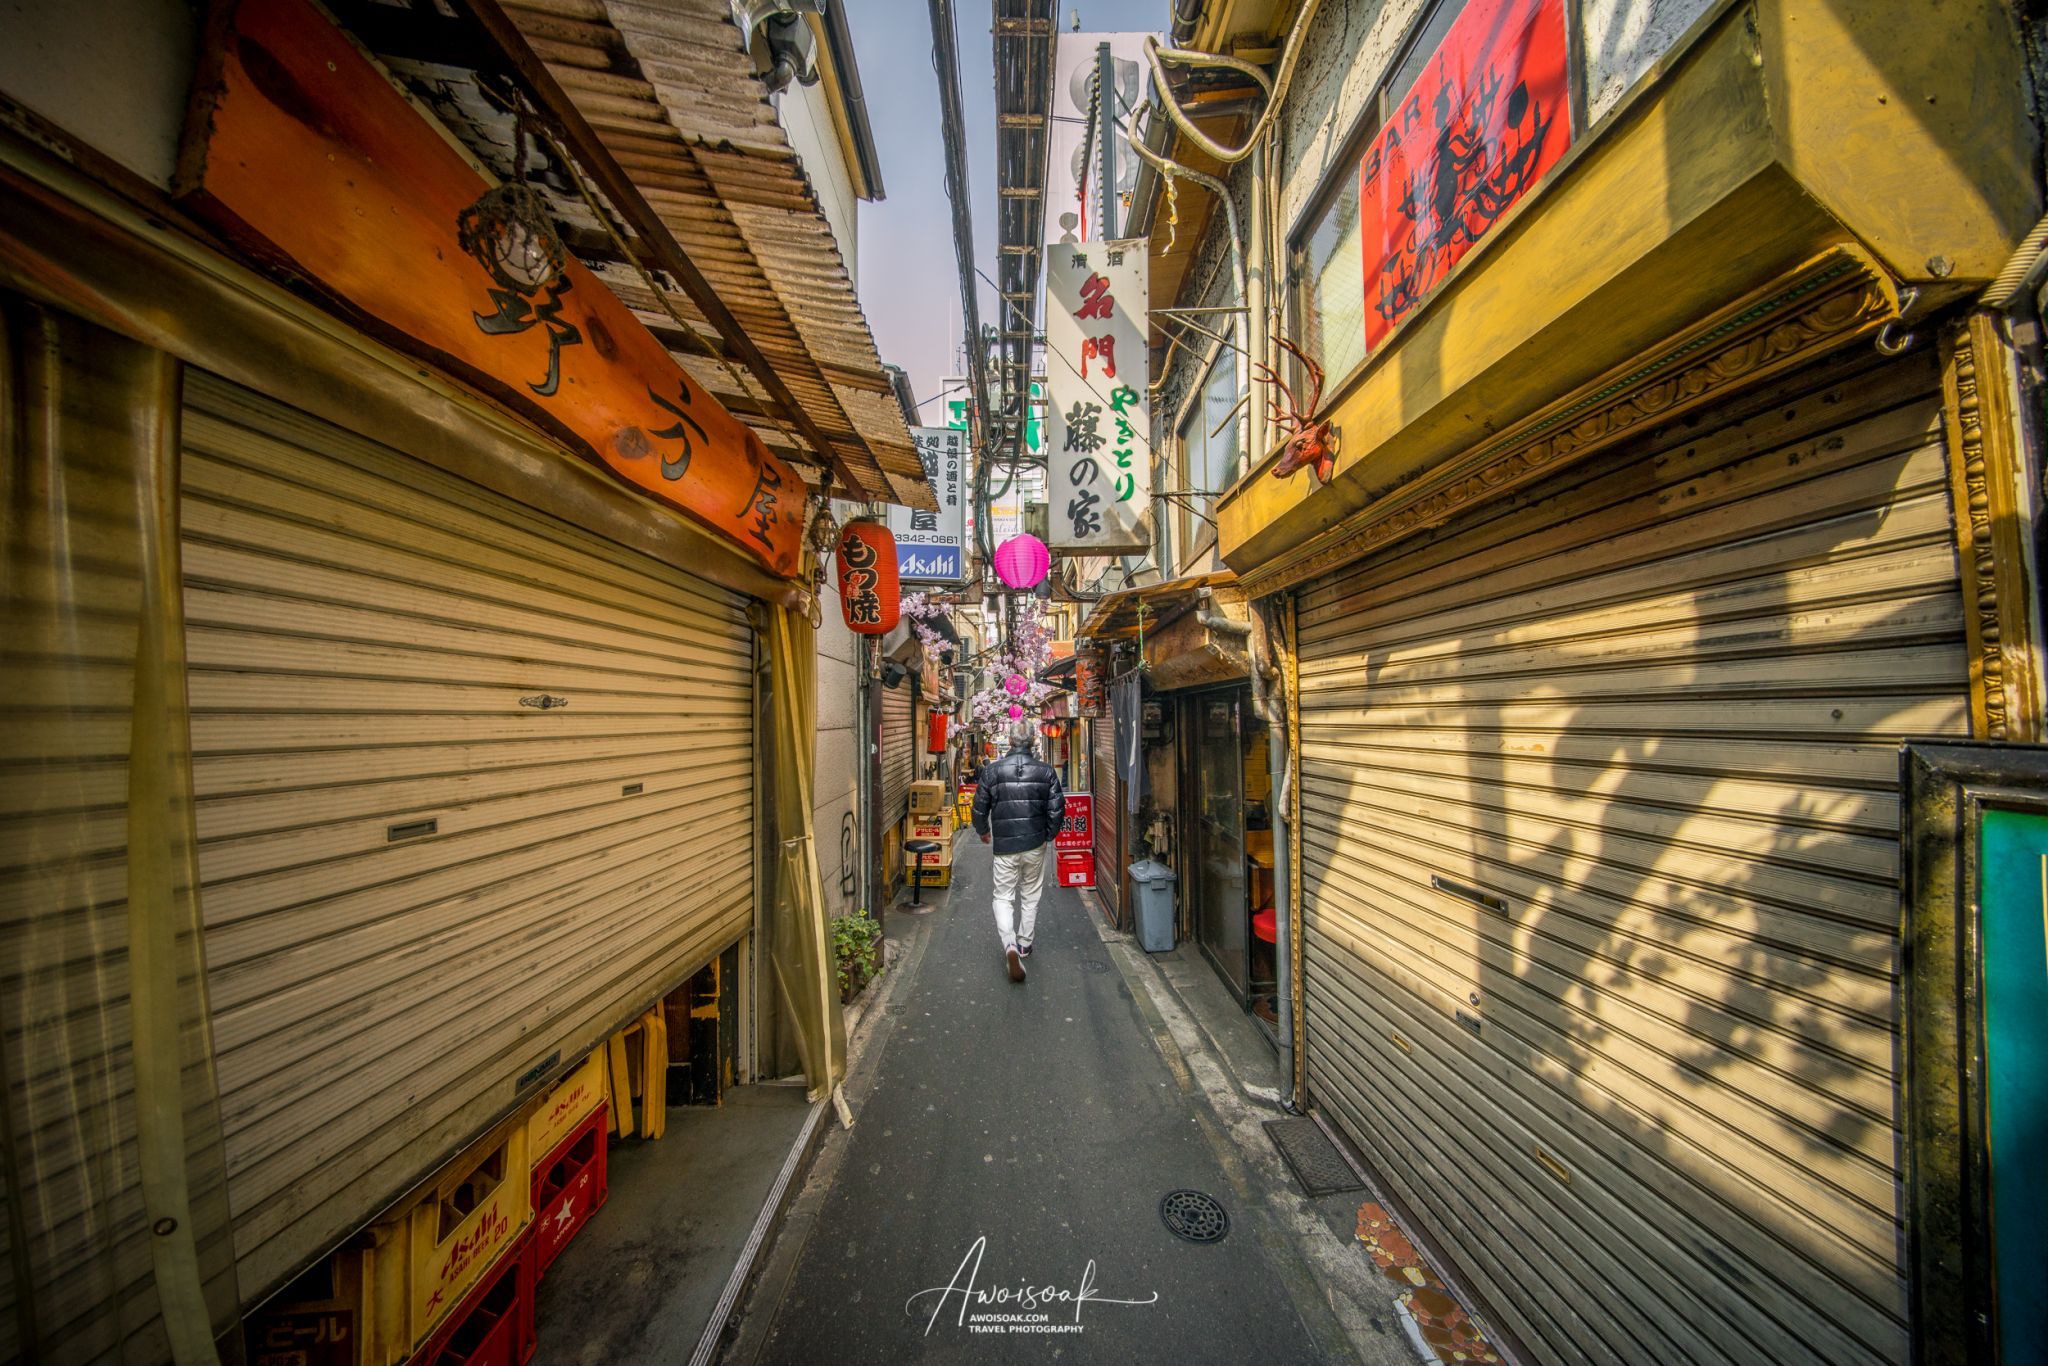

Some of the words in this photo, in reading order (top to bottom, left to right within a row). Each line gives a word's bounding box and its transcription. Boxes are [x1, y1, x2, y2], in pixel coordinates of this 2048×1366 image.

[1365, 98, 1422, 184] BAR
[1074, 272, 1116, 379] 名門
[1064, 401, 1107, 538] 藤の家
[1110, 385, 1140, 502] やきとり
[842, 534, 881, 624] もつ焼
[895, 534, 958, 545] 3342-0661
[899, 553, 954, 576] Asahi
[440, 1200, 498, 1281] Asahi
[494, 1215, 508, 1244] 20
